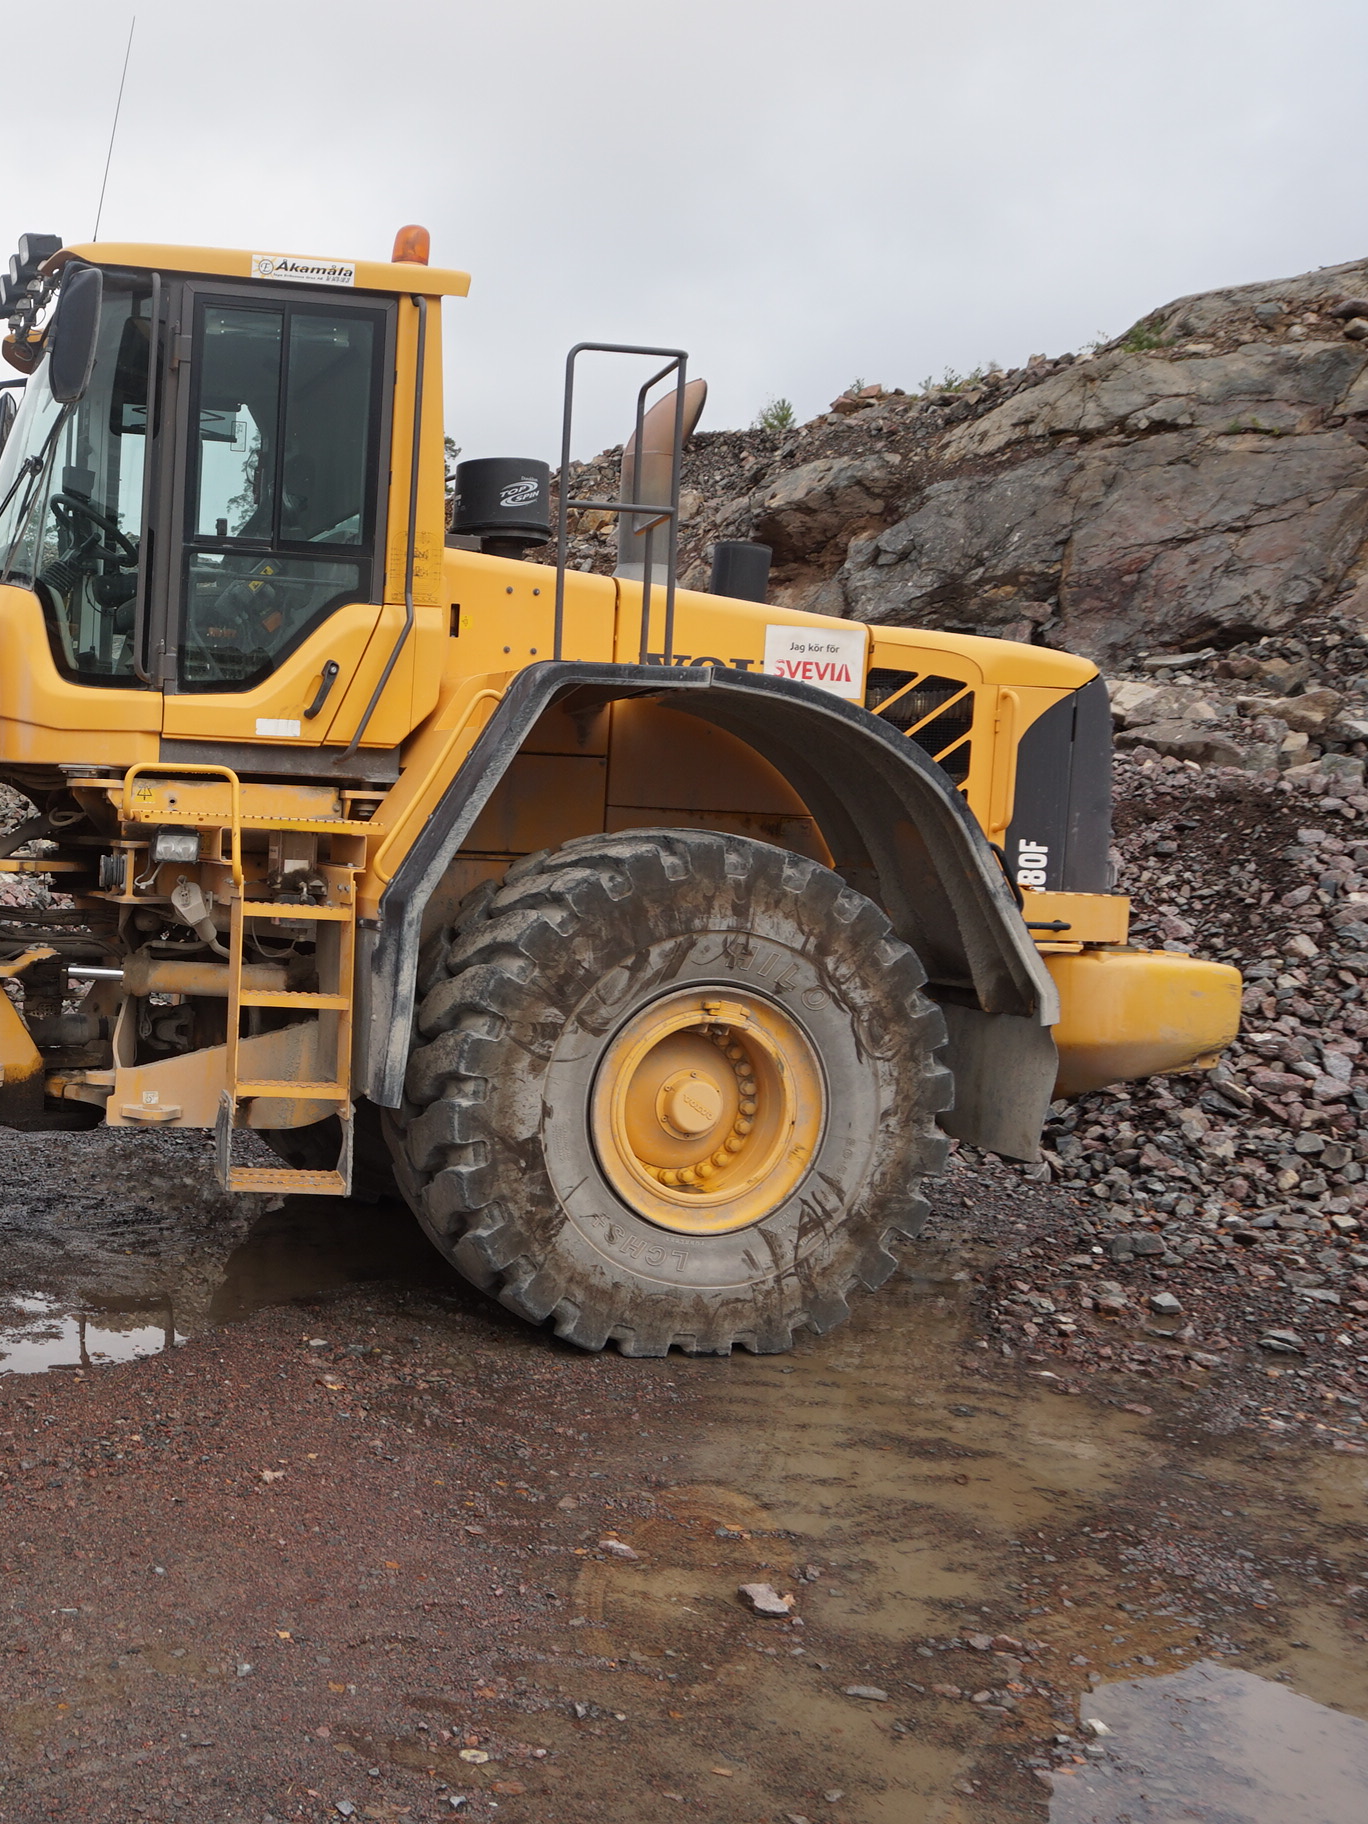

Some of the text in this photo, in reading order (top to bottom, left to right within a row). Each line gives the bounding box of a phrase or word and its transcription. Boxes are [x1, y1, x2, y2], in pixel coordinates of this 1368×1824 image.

[275, 259, 353, 277] Åkamåla
[500, 486, 527, 498] TOP
[514, 490, 540, 502] SPIN
[790, 642, 840, 653] Jag kör för
[774, 659, 852, 683] SVEVIA
[725, 942, 832, 1012] HILO
